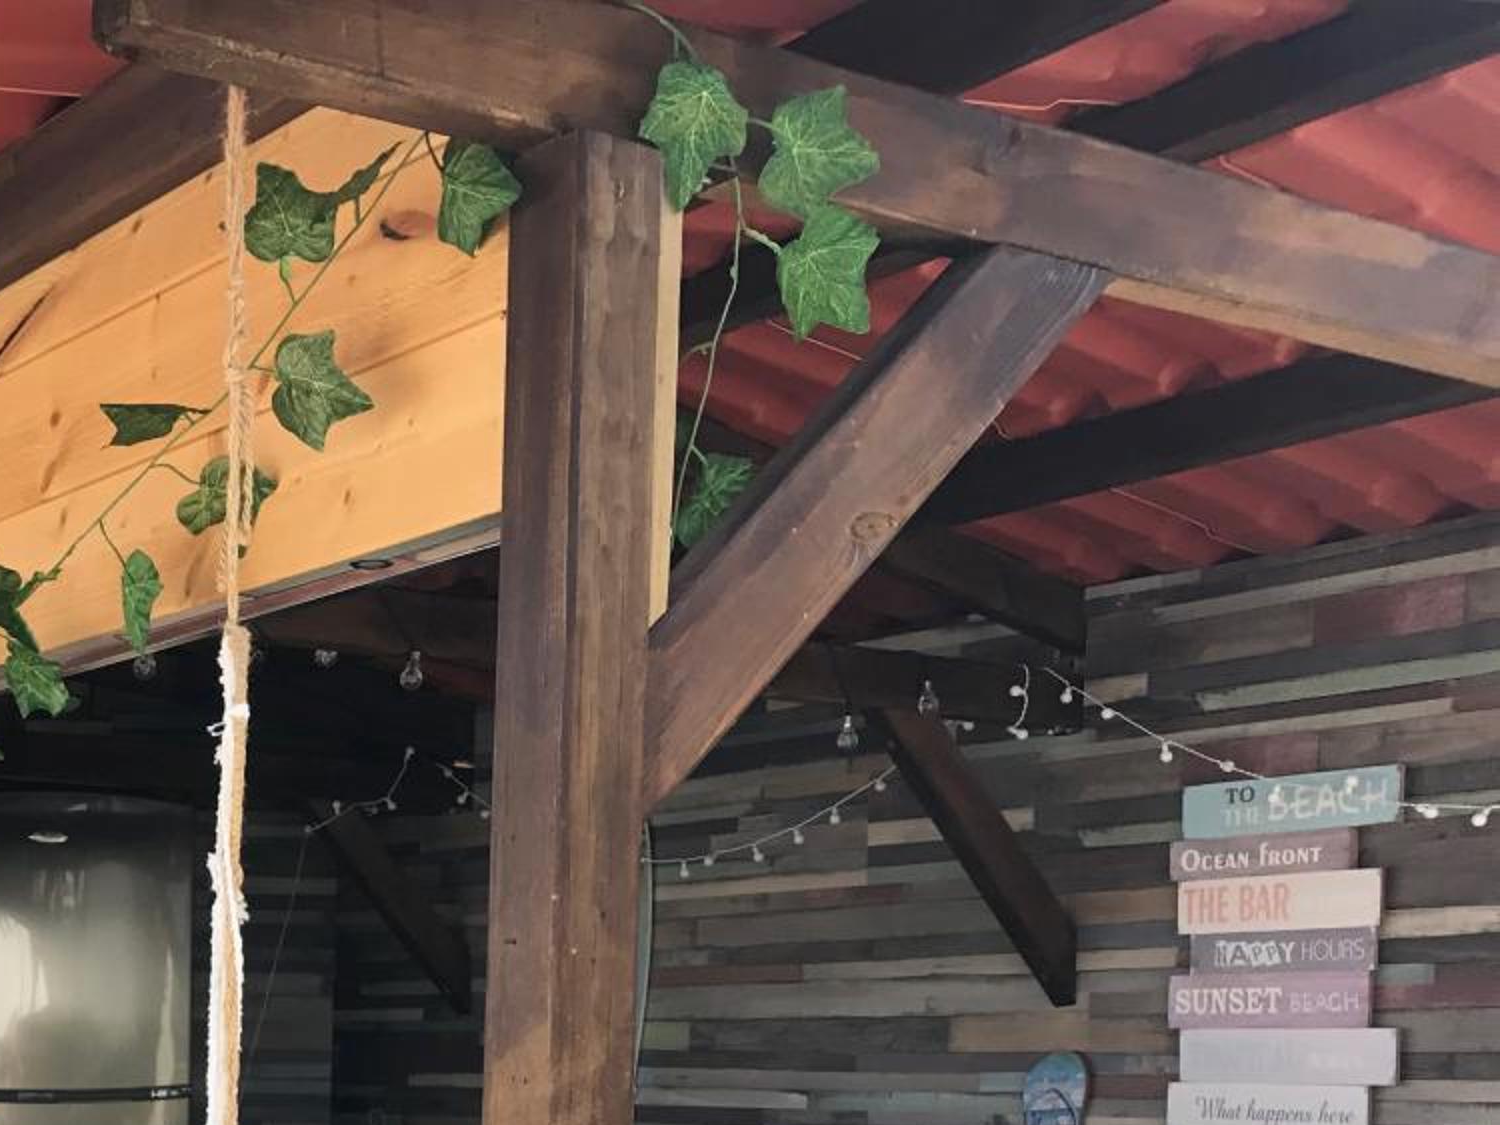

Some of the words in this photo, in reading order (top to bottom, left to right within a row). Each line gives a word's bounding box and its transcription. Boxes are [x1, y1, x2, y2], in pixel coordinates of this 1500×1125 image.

[1225, 786, 1255, 804] TO
[1268, 778, 1387, 821] BEACH
[1184, 886, 1229, 925] THE
[1239, 882, 1291, 922] BAR
[1214, 939, 1296, 967] HAPPY
[1301, 938, 1365, 960] HOURS
[1175, 988, 1283, 1015] SUNSET
[1288, 992, 1361, 1012] BEACH
[1195, 1096, 1242, 1121] What
[1318, 1100, 1355, 1124] here
